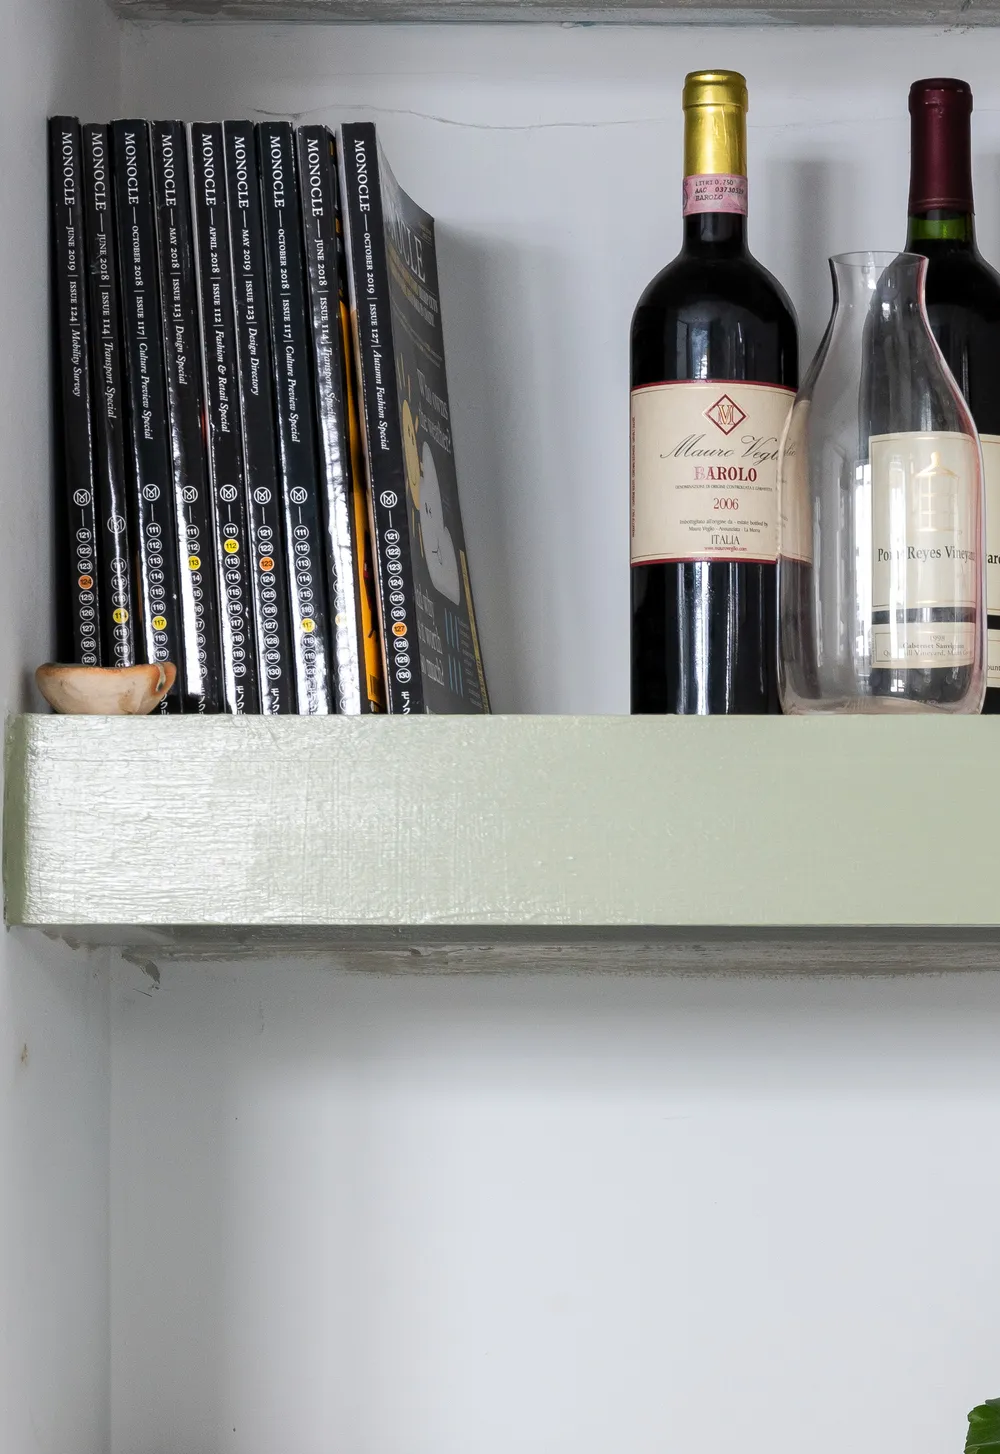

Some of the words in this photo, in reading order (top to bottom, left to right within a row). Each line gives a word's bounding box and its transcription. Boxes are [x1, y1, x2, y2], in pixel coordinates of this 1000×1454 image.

[62, 132, 75, 205] MONOCLE
[202, 134, 216, 206] MONOCLE
[234, 136, 249, 208] MONOCLE
[354, 139, 370, 212] MONOCLE
[66, 226, 75, 247] JUNE
[209, 226, 217, 250] APRIL
[242, 229, 250, 247] MAY
[67, 249, 77, 270] 2019
[211, 252, 220, 273] 2018
[243, 249, 251, 270] 2019
[363, 232, 374, 270] OCTOBER
[70, 281, 78, 304] ISSUE
[212, 283, 220, 305] ISSUE
[245, 280, 253, 303] ISSUE
[366, 273, 375, 294] 2019
[69, 306, 78, 322] 124
[246, 305, 254, 320] 123
[370, 304, 378, 326] ISSUE
[71, 329, 81, 365] Mobility
[215, 330, 225, 362] Fashion
[248, 328, 258, 355] Design
[371, 329, 379, 344] 127
[217, 364, 226, 374] &
[250, 357, 260, 396] Directory
[373, 350, 382, 384] Autumn
[73, 366, 82, 397] Survey
[218, 376, 228, 401] Retail
[376, 386, 386, 418] Fashion
[219, 403, 230, 432] Special
[377, 420, 389, 450] Special
[660, 434, 734, 459] Mauro
[694, 466, 757, 482] BAROLO
[713, 498, 738, 510] 2006
[711, 535, 740, 545] ITALIA
[908, 546, 941, 562] Reyes
